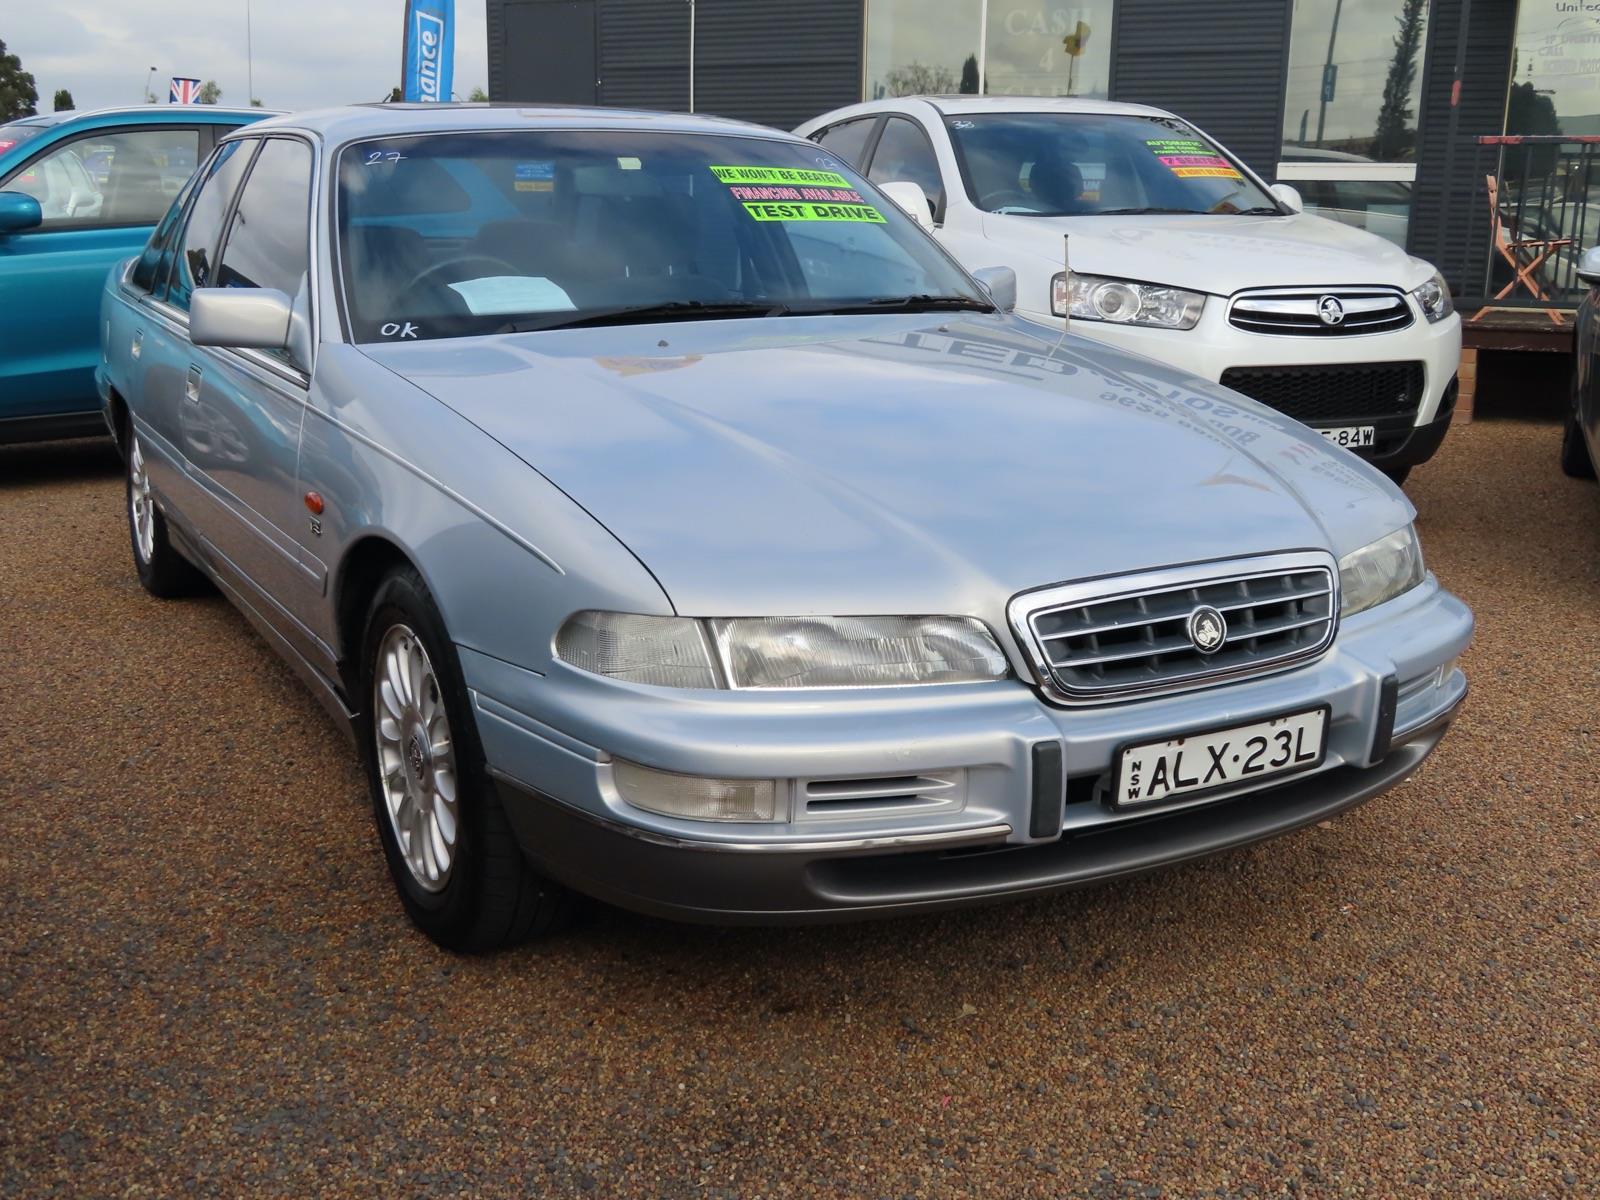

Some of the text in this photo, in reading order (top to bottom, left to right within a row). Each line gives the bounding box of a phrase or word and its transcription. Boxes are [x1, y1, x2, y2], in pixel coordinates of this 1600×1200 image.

[1004, 8, 1091, 35] CASH
[1040, 48, 1054, 72] 4
[365, 152, 408, 165] 27
[713, 168, 843, 183] WE WON'T BE BEATEN
[729, 186, 864, 202] FINANCING AVAILABLE
[749, 205, 879, 219] TEST DRIVE
[1128, 760, 1142, 799] NSW
